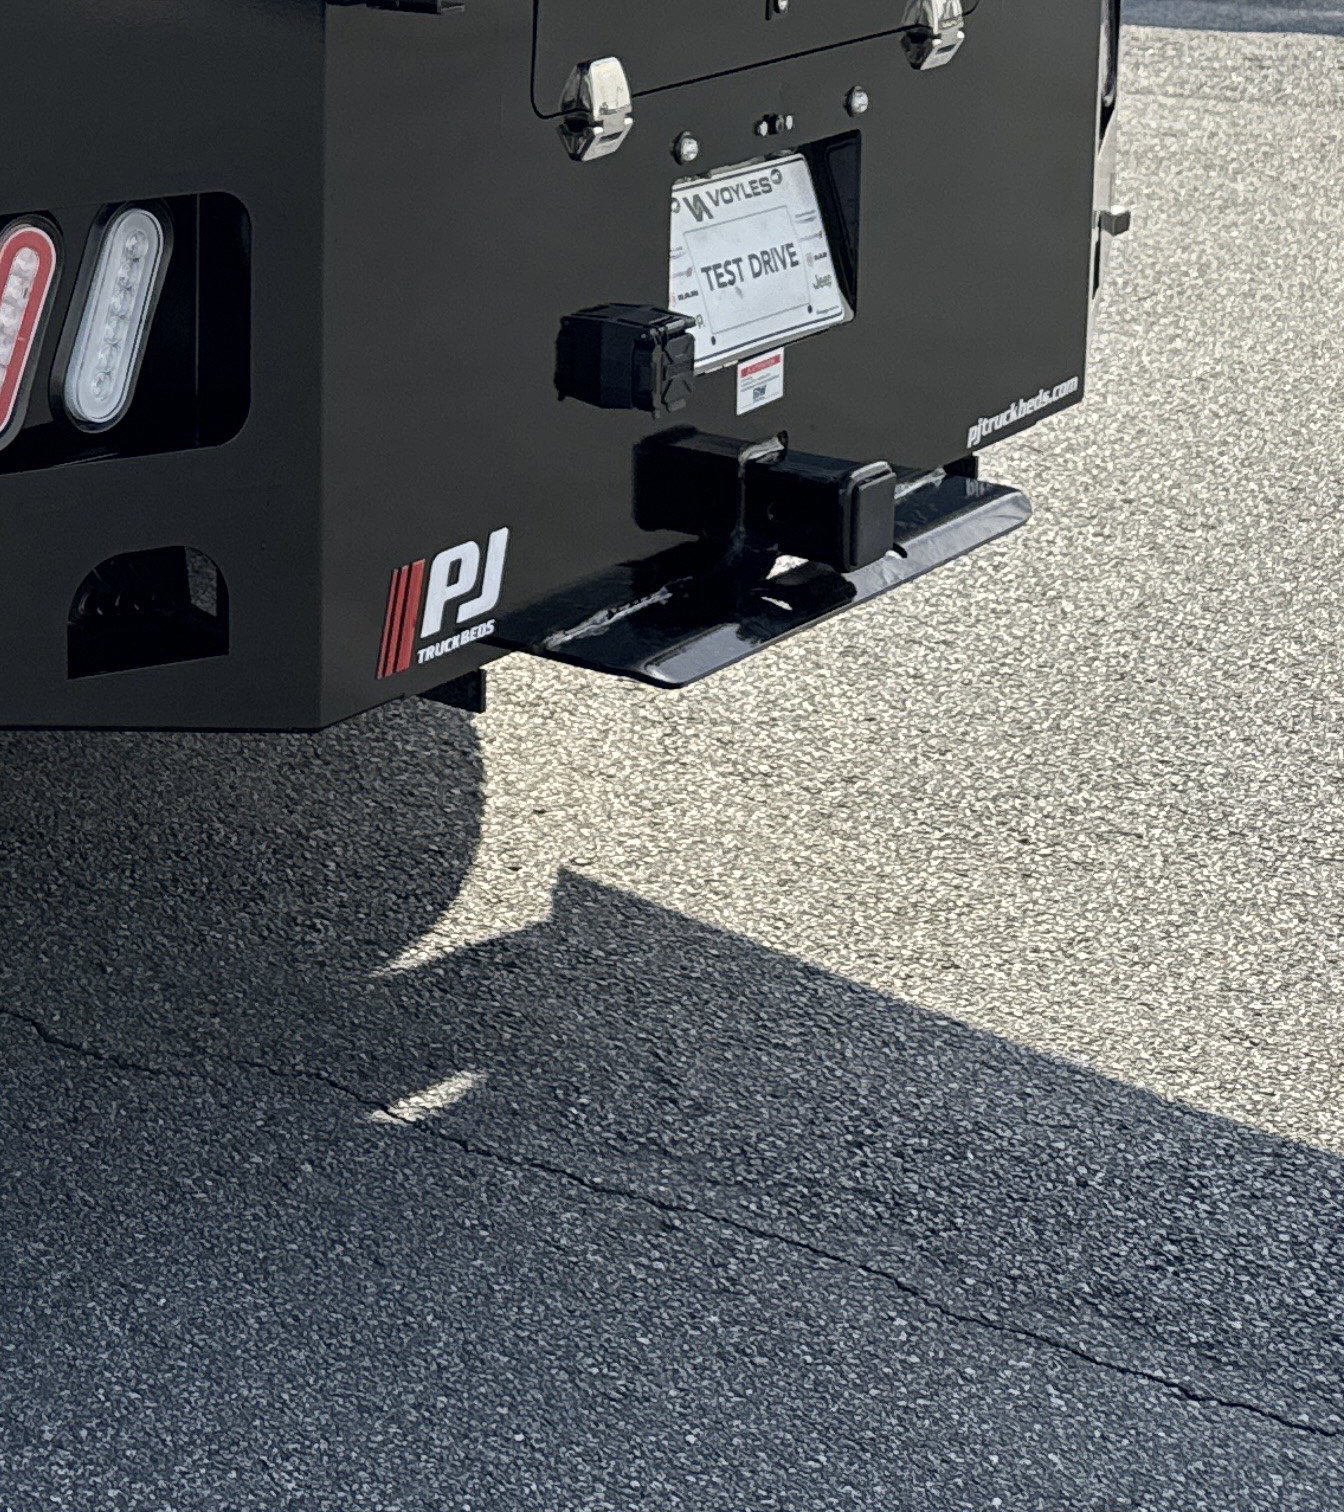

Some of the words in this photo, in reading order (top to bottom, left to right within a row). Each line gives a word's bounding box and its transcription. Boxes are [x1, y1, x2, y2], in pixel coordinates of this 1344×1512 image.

[705, 176, 774, 207] VOYLES
[700, 256, 745, 291] TEST
[748, 242, 799, 279] DRIVE
[966, 375, 1080, 449] pjtruckbeds.com
[420, 526, 509, 639] PJ
